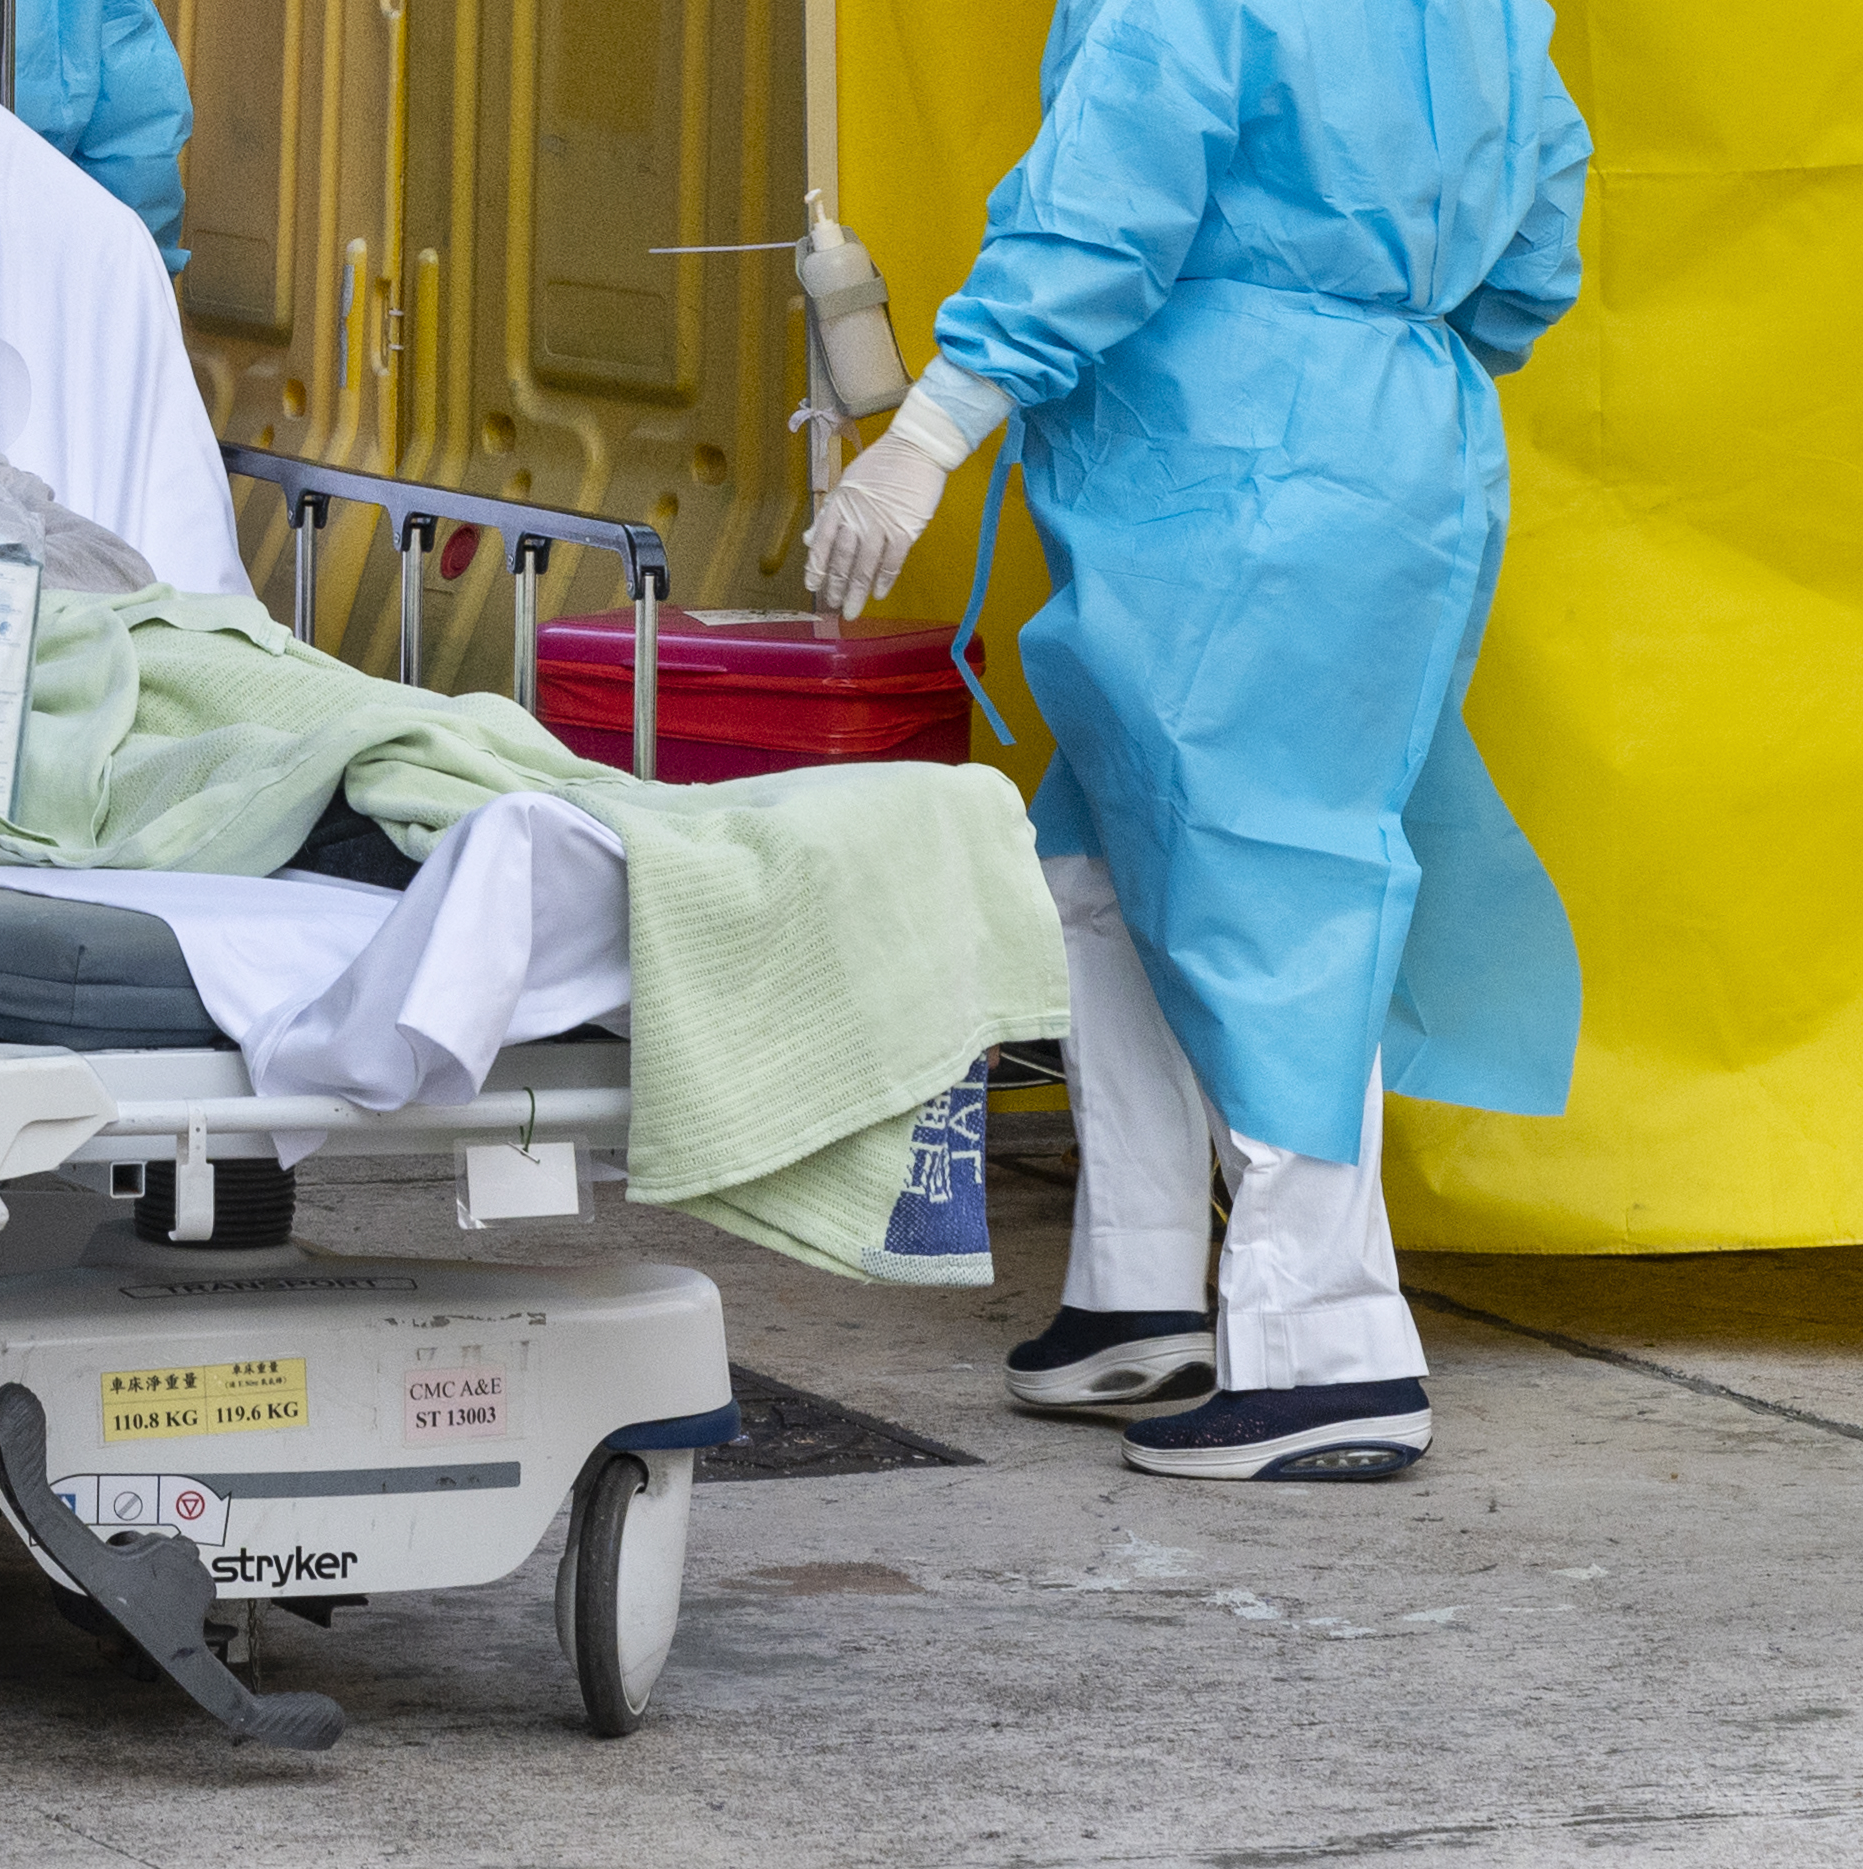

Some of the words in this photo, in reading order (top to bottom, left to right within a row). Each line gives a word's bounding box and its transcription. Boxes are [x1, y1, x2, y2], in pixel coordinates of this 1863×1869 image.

[157, 1279, 376, 1295] TRANSPORT
[409, 1381, 456, 1402] CMC
[460, 1377, 503, 1397] A&E
[114, 1412, 160, 1431] 110.8
[166, 1409, 199, 1428] KG
[217, 1404, 261, 1424] 119.6
[268, 1401, 299, 1420] KG
[415, 1410, 441, 1430] ST
[447, 1406, 498, 1428] 13003
[211, 1545, 359, 1588] stryker
